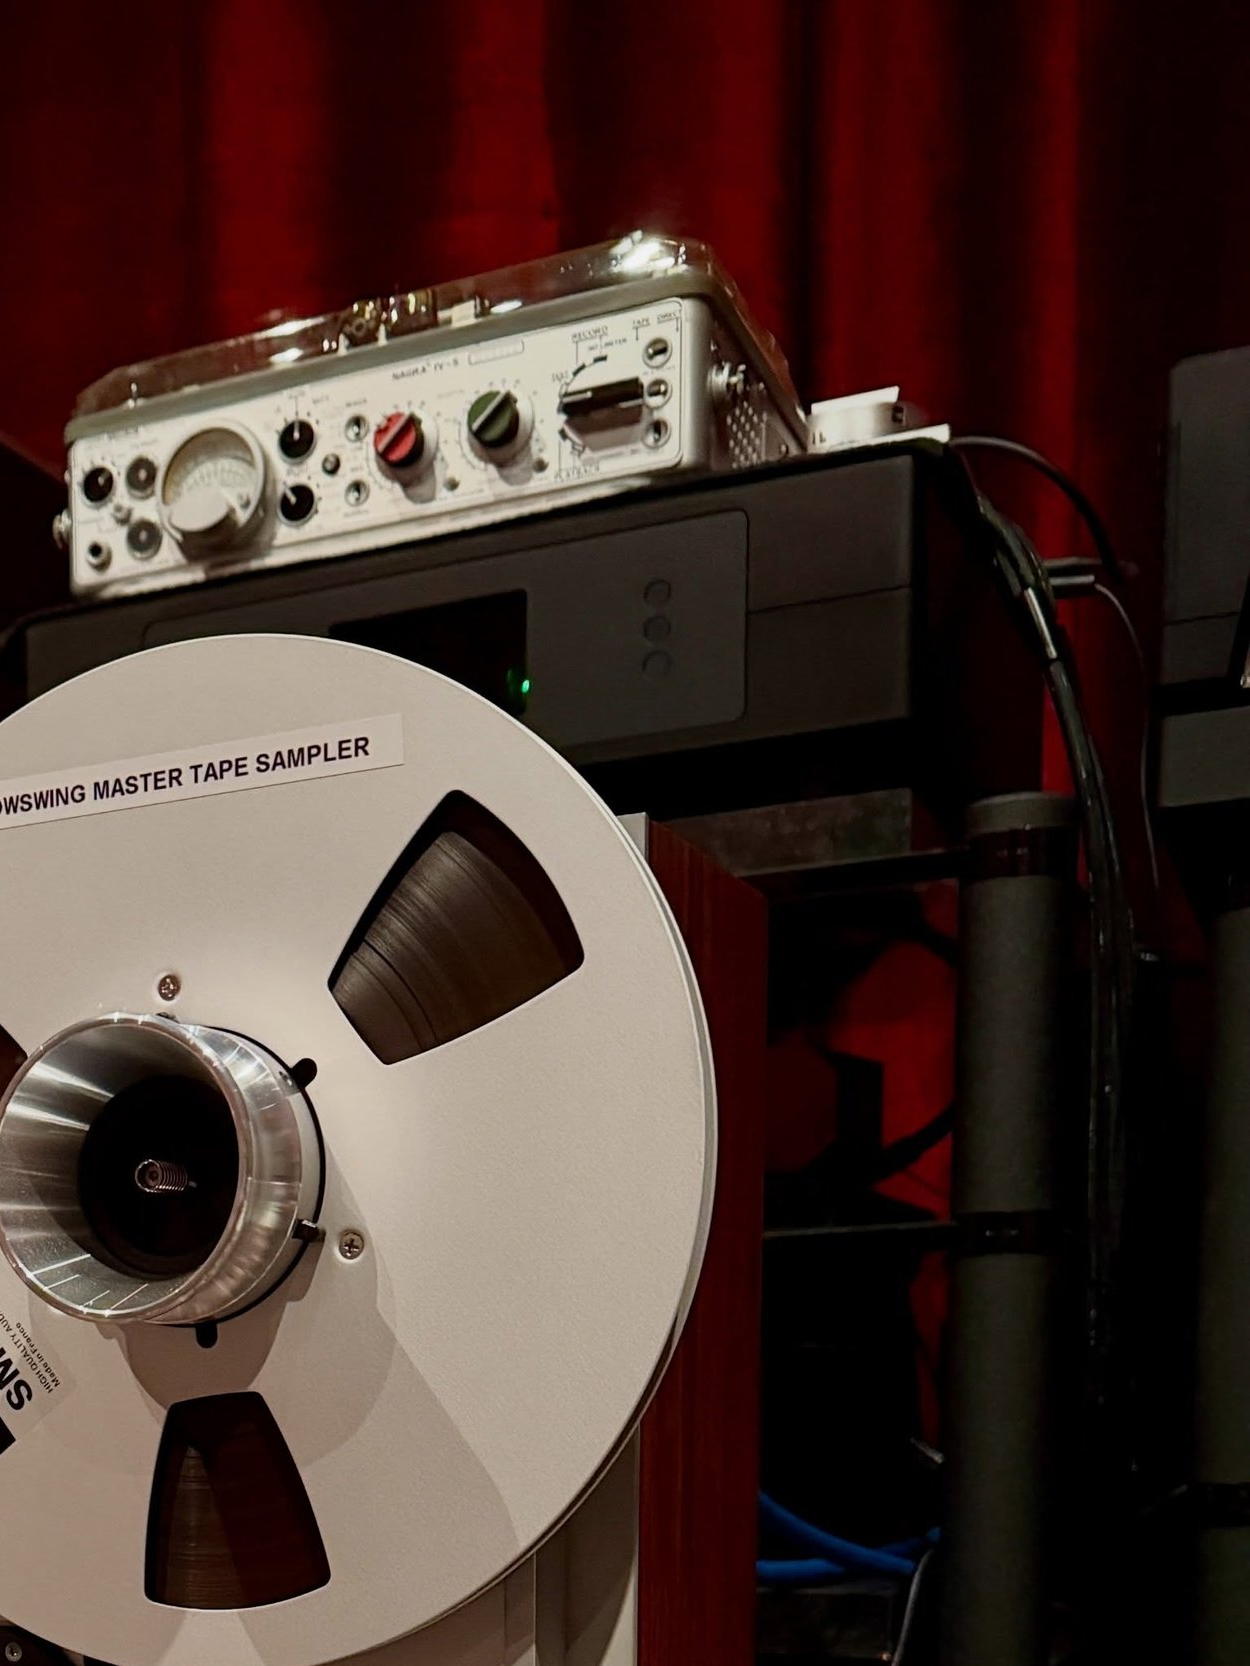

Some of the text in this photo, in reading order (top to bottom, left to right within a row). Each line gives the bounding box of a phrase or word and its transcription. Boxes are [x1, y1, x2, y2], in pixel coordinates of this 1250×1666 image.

[93, 767, 183, 800] MASTER
[189, 756, 249, 785] TAPE
[255, 736, 370, 773] SAMPLER
[10, 1333, 38, 1371] QUALITY
[35, 1370, 53, 1393] HIGH
